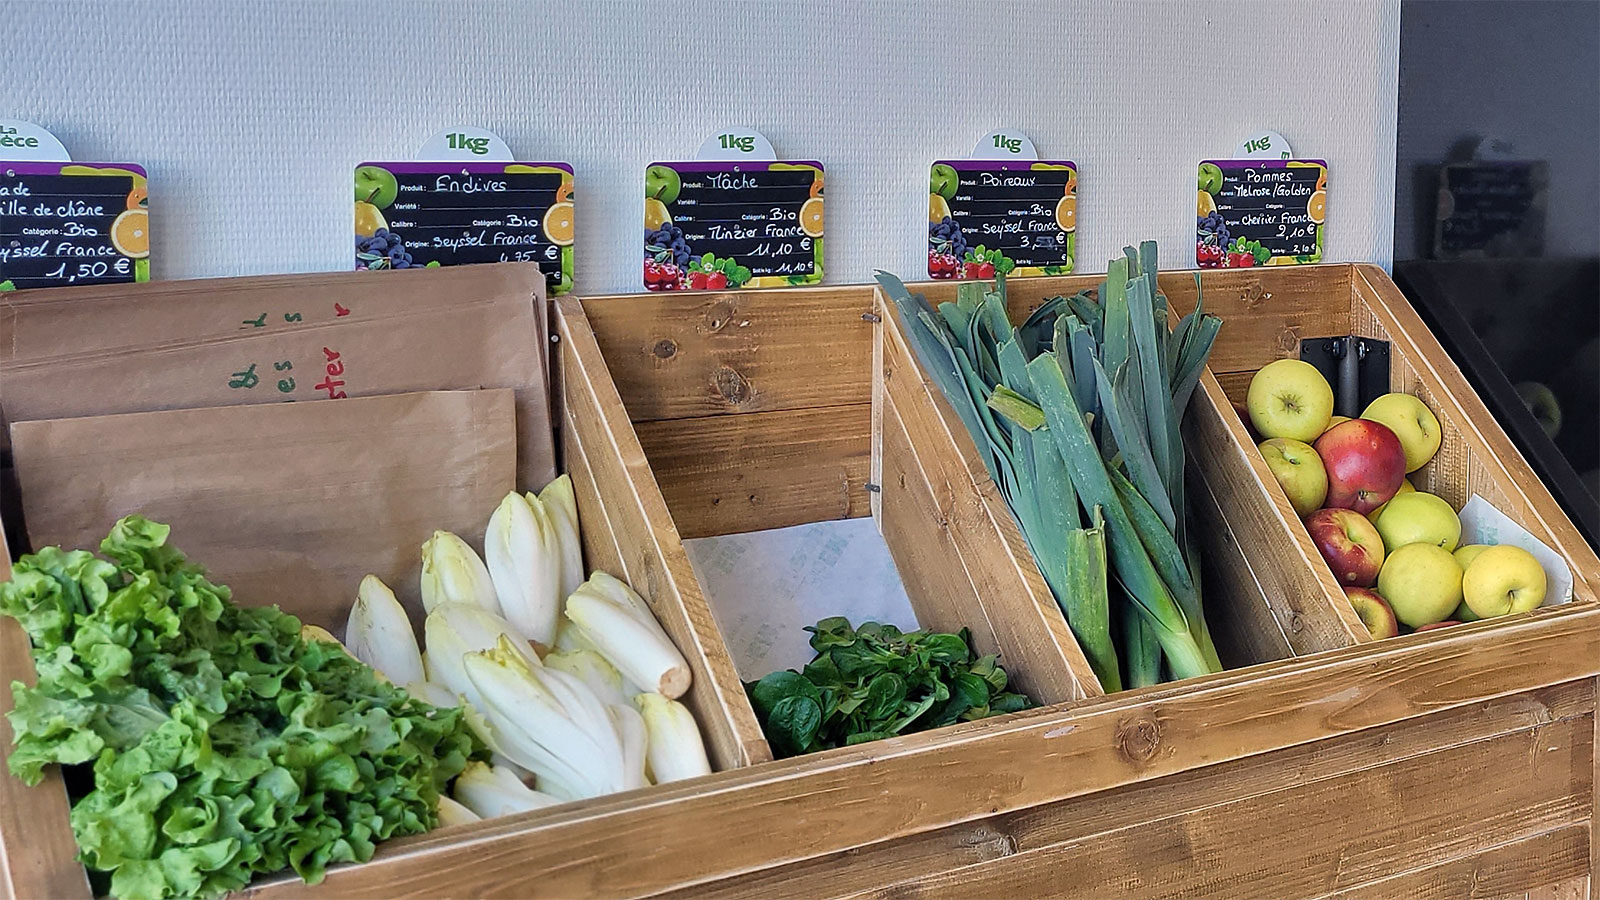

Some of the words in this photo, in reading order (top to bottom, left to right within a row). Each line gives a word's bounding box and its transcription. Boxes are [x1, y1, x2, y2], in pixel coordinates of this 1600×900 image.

[0, 125, 17, 134] La
[446, 133, 490, 154] 1kg
[718, 134, 755, 152] 1kg
[993, 134, 1022, 153] 1kg
[1244, 136, 1271, 153] 1kg
[980, 172, 1036, 186] Poireaux
[1244, 168, 1294, 183] Pommes
[435, 174, 507, 193] Endives
[33, 203, 53, 216] de
[57, 200, 104, 217] chêne
[769, 207, 797, 220] Bio
[1030, 203, 1052, 217] Bio
[506, 214, 538, 227] Bio
[1028, 220, 1058, 232] France
[63, 222, 98, 236] Bio
[765, 224, 804, 237] France
[1275, 224, 1305, 240] 2,10
[1306, 223, 1316, 235] €
[493, 231, 538, 245] France
[1056, 231, 1065, 244] €
[56, 242, 116, 256] France
[544, 245, 558, 259] €
[747, 243, 792, 258] 11,10
[800, 237, 811, 250] €
[1293, 244, 1310, 254] 2,10
[45, 263, 107, 282] 1,50
[114, 258, 130, 274] €
[775, 262, 805, 274] 11,10
[807, 261, 813, 269] €
